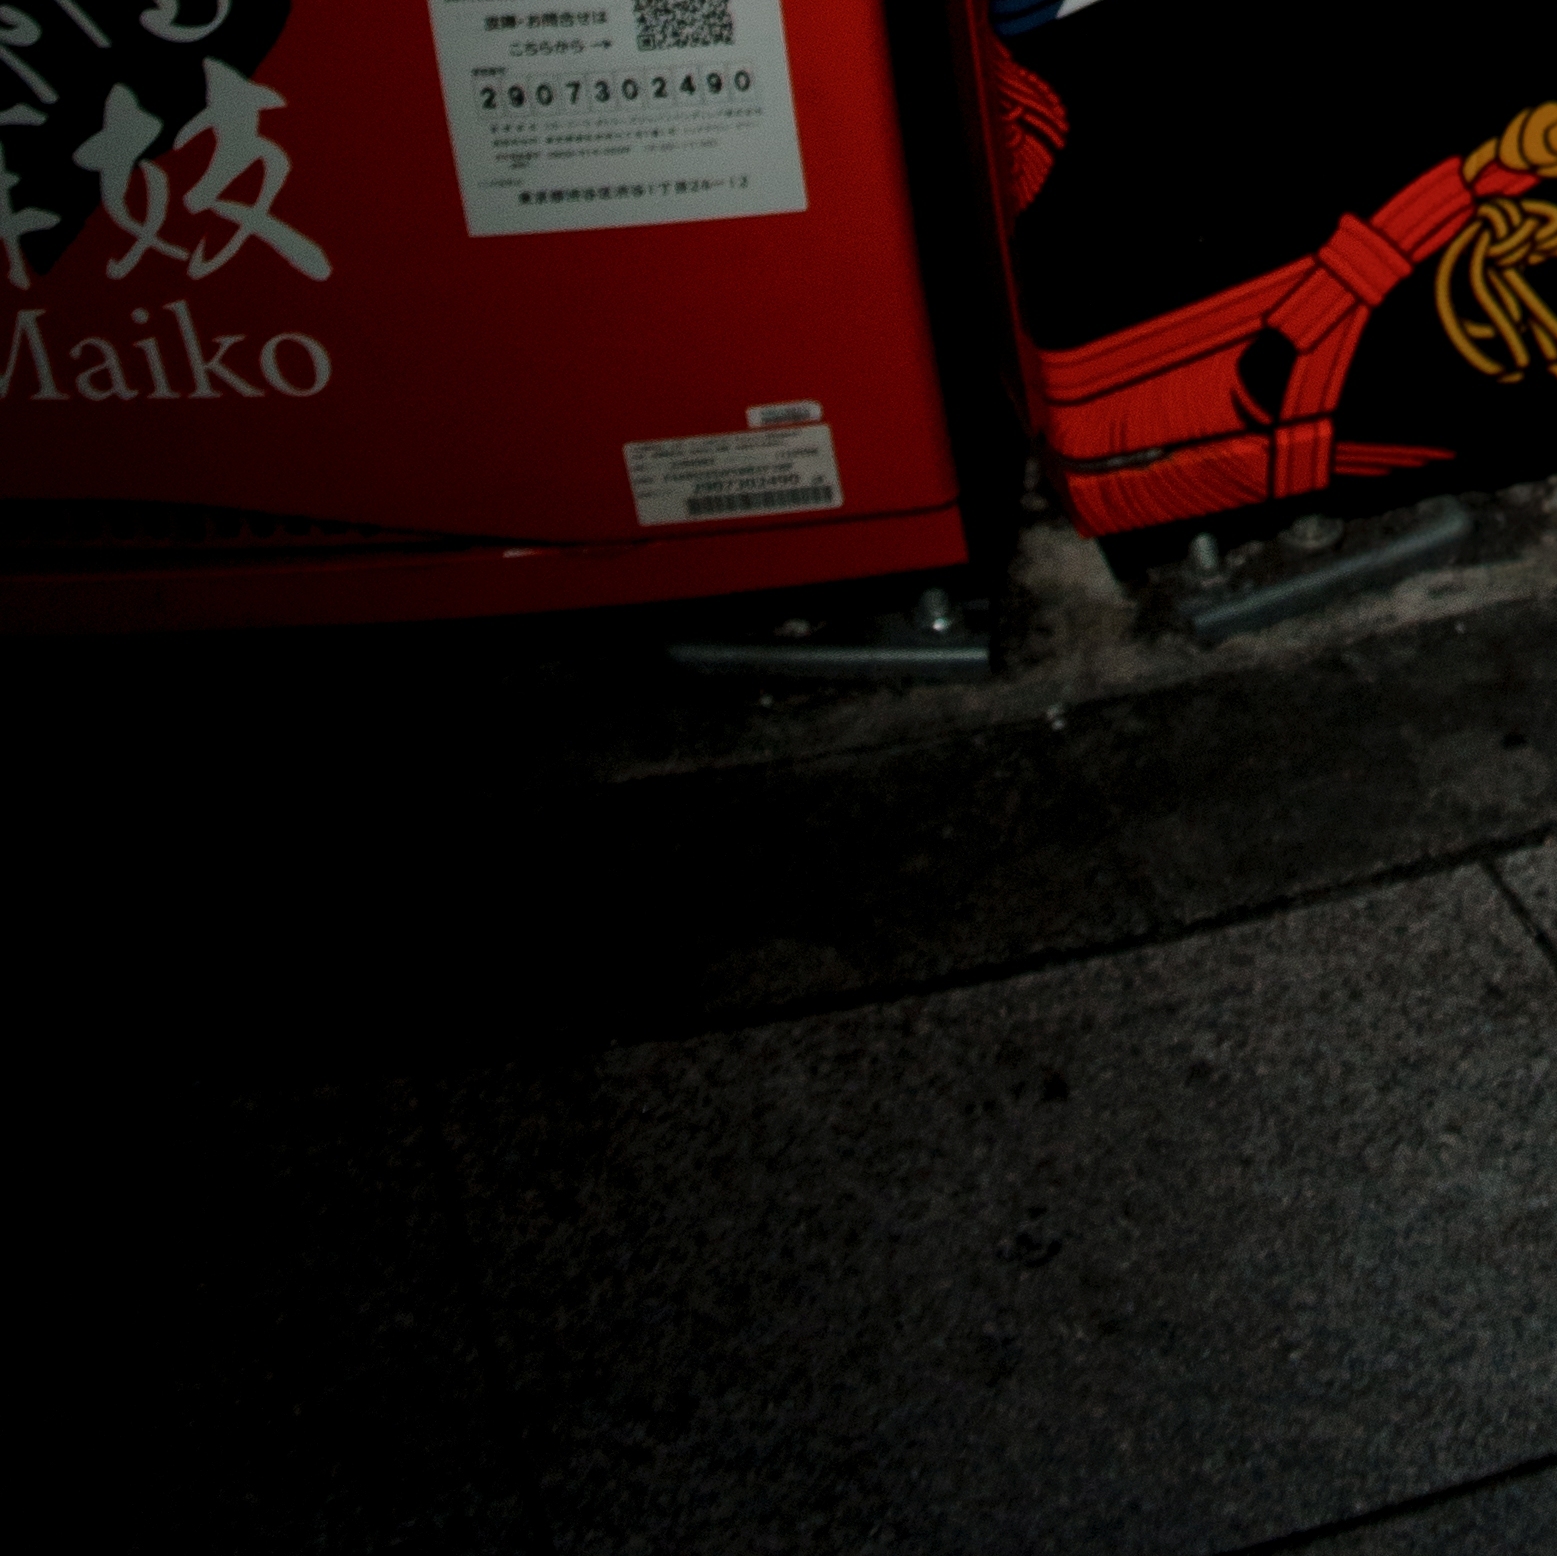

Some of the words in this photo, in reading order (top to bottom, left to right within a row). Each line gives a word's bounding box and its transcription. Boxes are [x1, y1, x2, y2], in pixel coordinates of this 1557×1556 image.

[508, 39, 586, 59] こちらから
